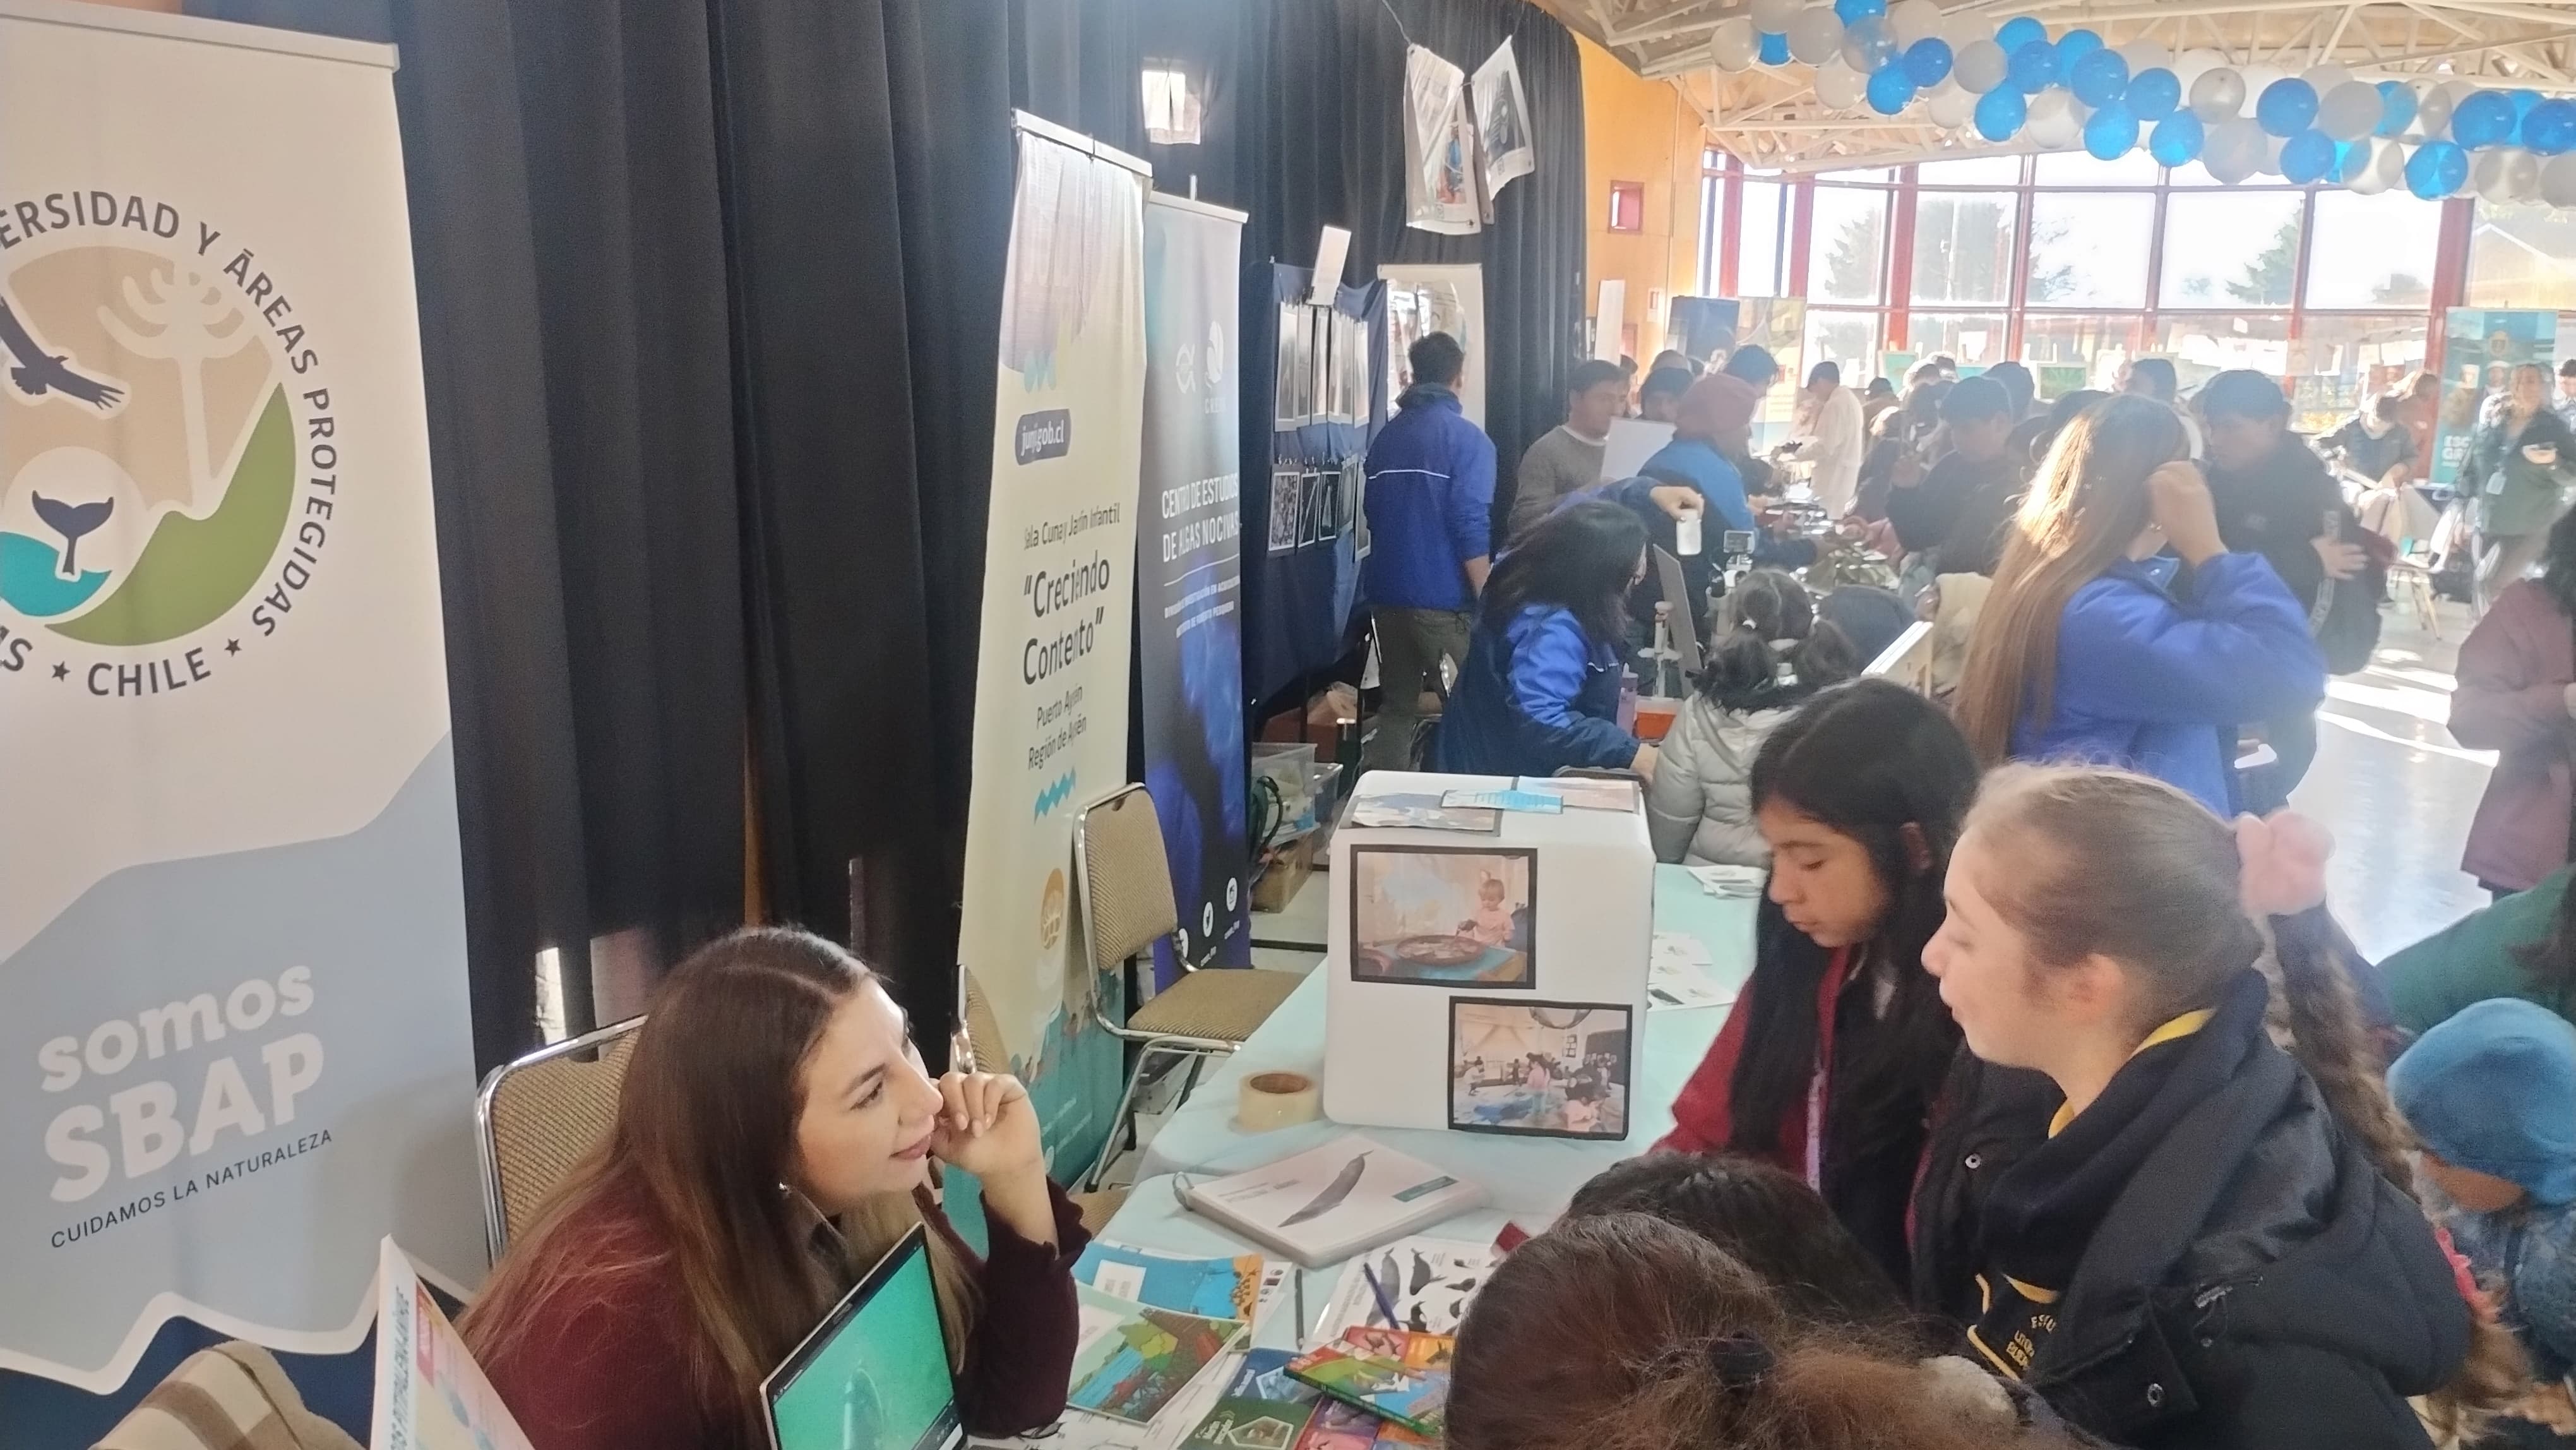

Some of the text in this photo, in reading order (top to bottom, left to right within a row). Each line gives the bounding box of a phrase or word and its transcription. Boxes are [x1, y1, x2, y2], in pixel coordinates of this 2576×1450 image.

[196, 222, 220, 257] Y
[252, 388, 338, 637] PROTEGIDAS
[1023, 524, 1040, 551] ala
[1068, 510, 1088, 537] Jaín
[1090, 503, 1121, 529] Ifantil
[1162, 483, 1190, 519] CENTO
[1191, 481, 1201, 510] DE
[1163, 531, 1178, 563] DE
[1202, 510, 1239, 546] NOCIVAS
[88, 647, 212, 697] CHILE
[1037, 682, 1083, 731] Puerto Ayn
[1028, 712, 1087, 770] Región de Aén
[39, 965, 315, 1092] somos
[44, 1033, 325, 1202] SBAP
[51, 1129, 333, 1249] CUIDAMOS LA NATURALEZA
